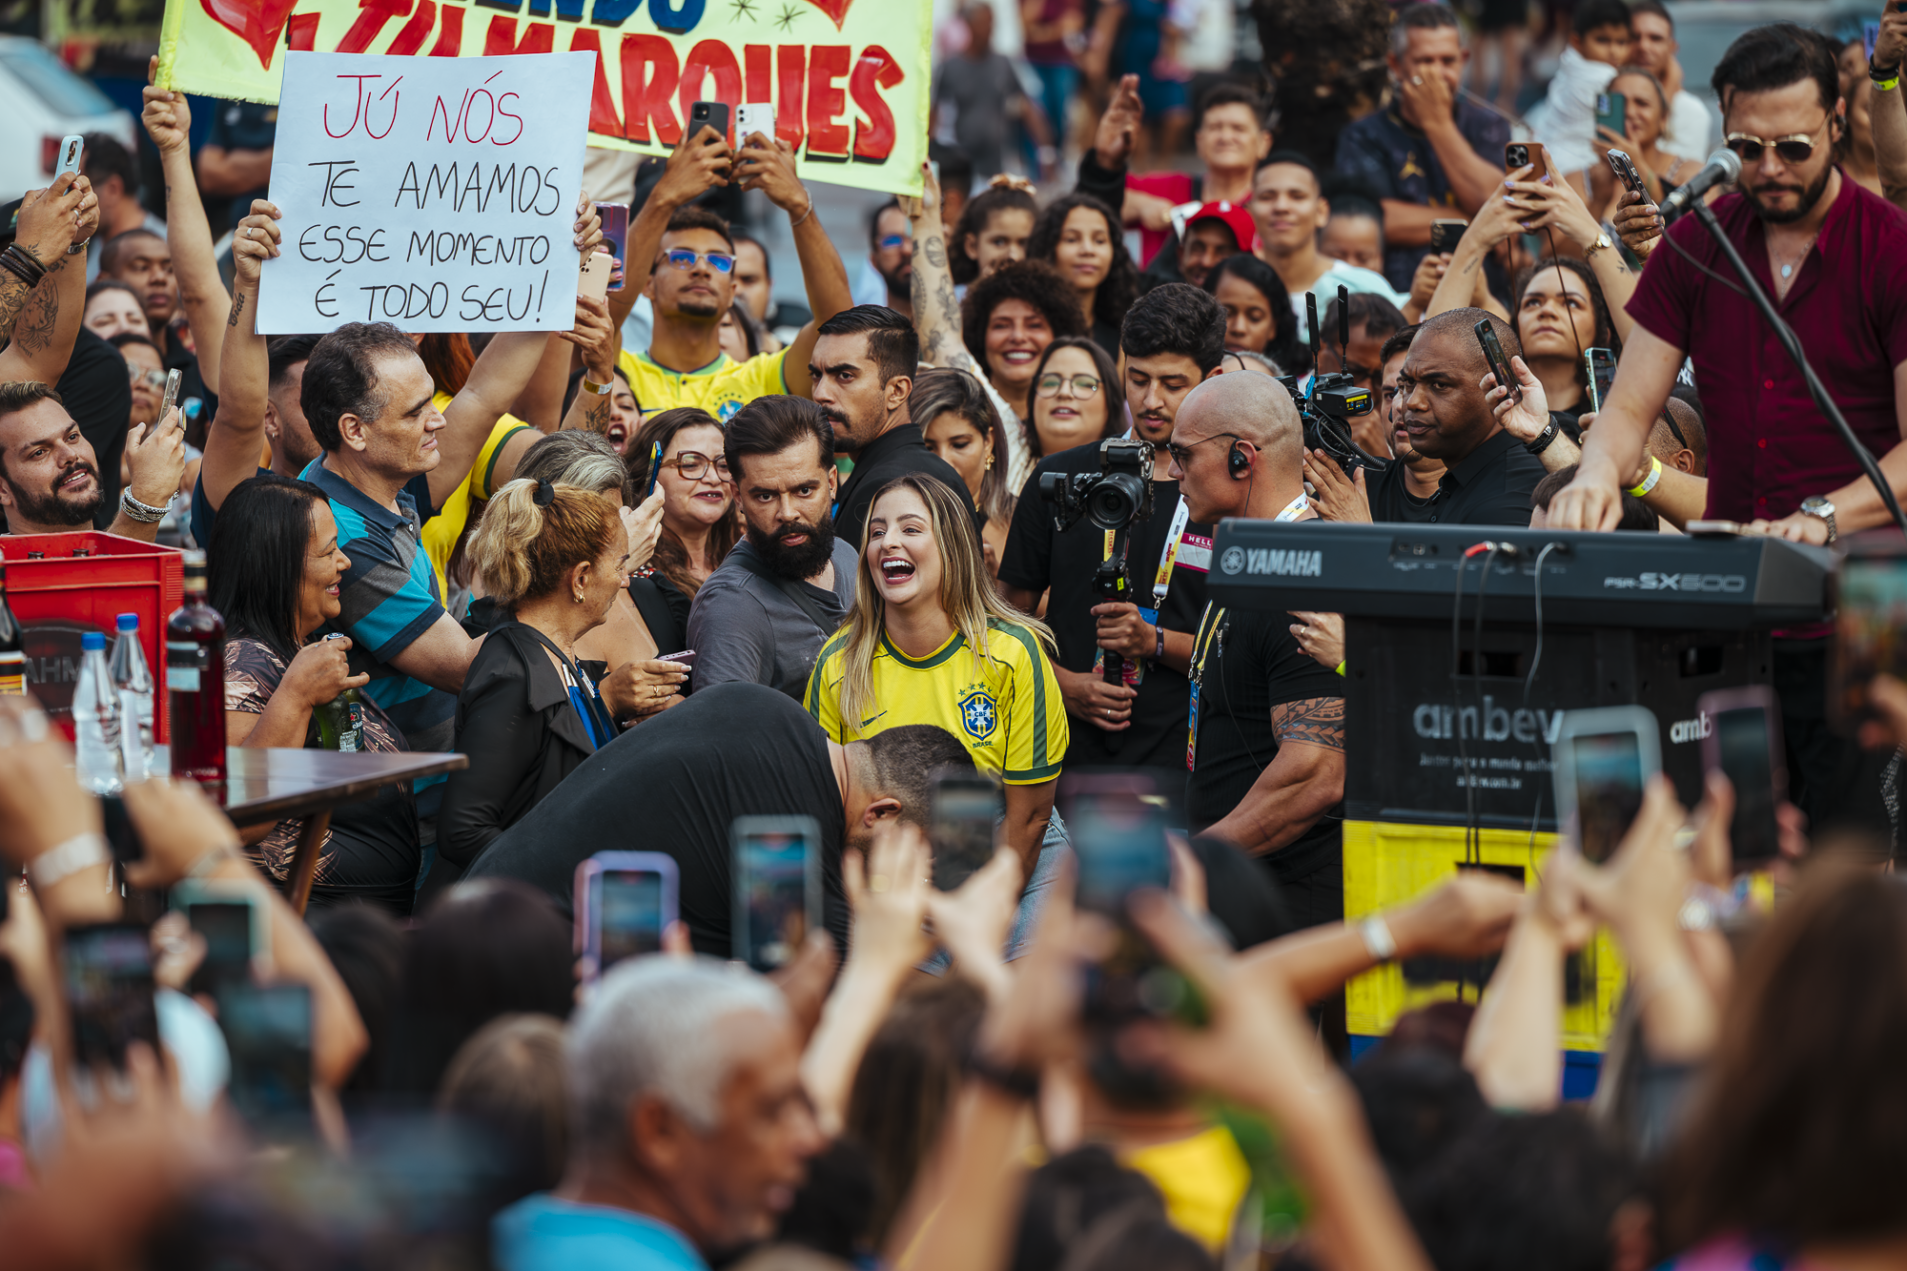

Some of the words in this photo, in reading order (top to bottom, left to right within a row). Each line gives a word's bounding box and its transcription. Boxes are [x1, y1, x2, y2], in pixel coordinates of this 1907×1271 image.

[324, 74, 403, 140] JÚ
[426, 69, 524, 146] NÓS
[483, 14, 904, 165] ARQUES
[308, 159, 361, 208] TE
[394, 160, 561, 217] AMAMOS
[299, 223, 390, 264] ESSE
[406, 229, 550, 267] MOMENTO
[314, 268, 343, 318] É
[359, 281, 449, 322] TODO
[459, 269, 549, 323] SEU!
[1246, 547, 1323, 578] YAMAHA
[1412, 694, 1566, 745] ambev
